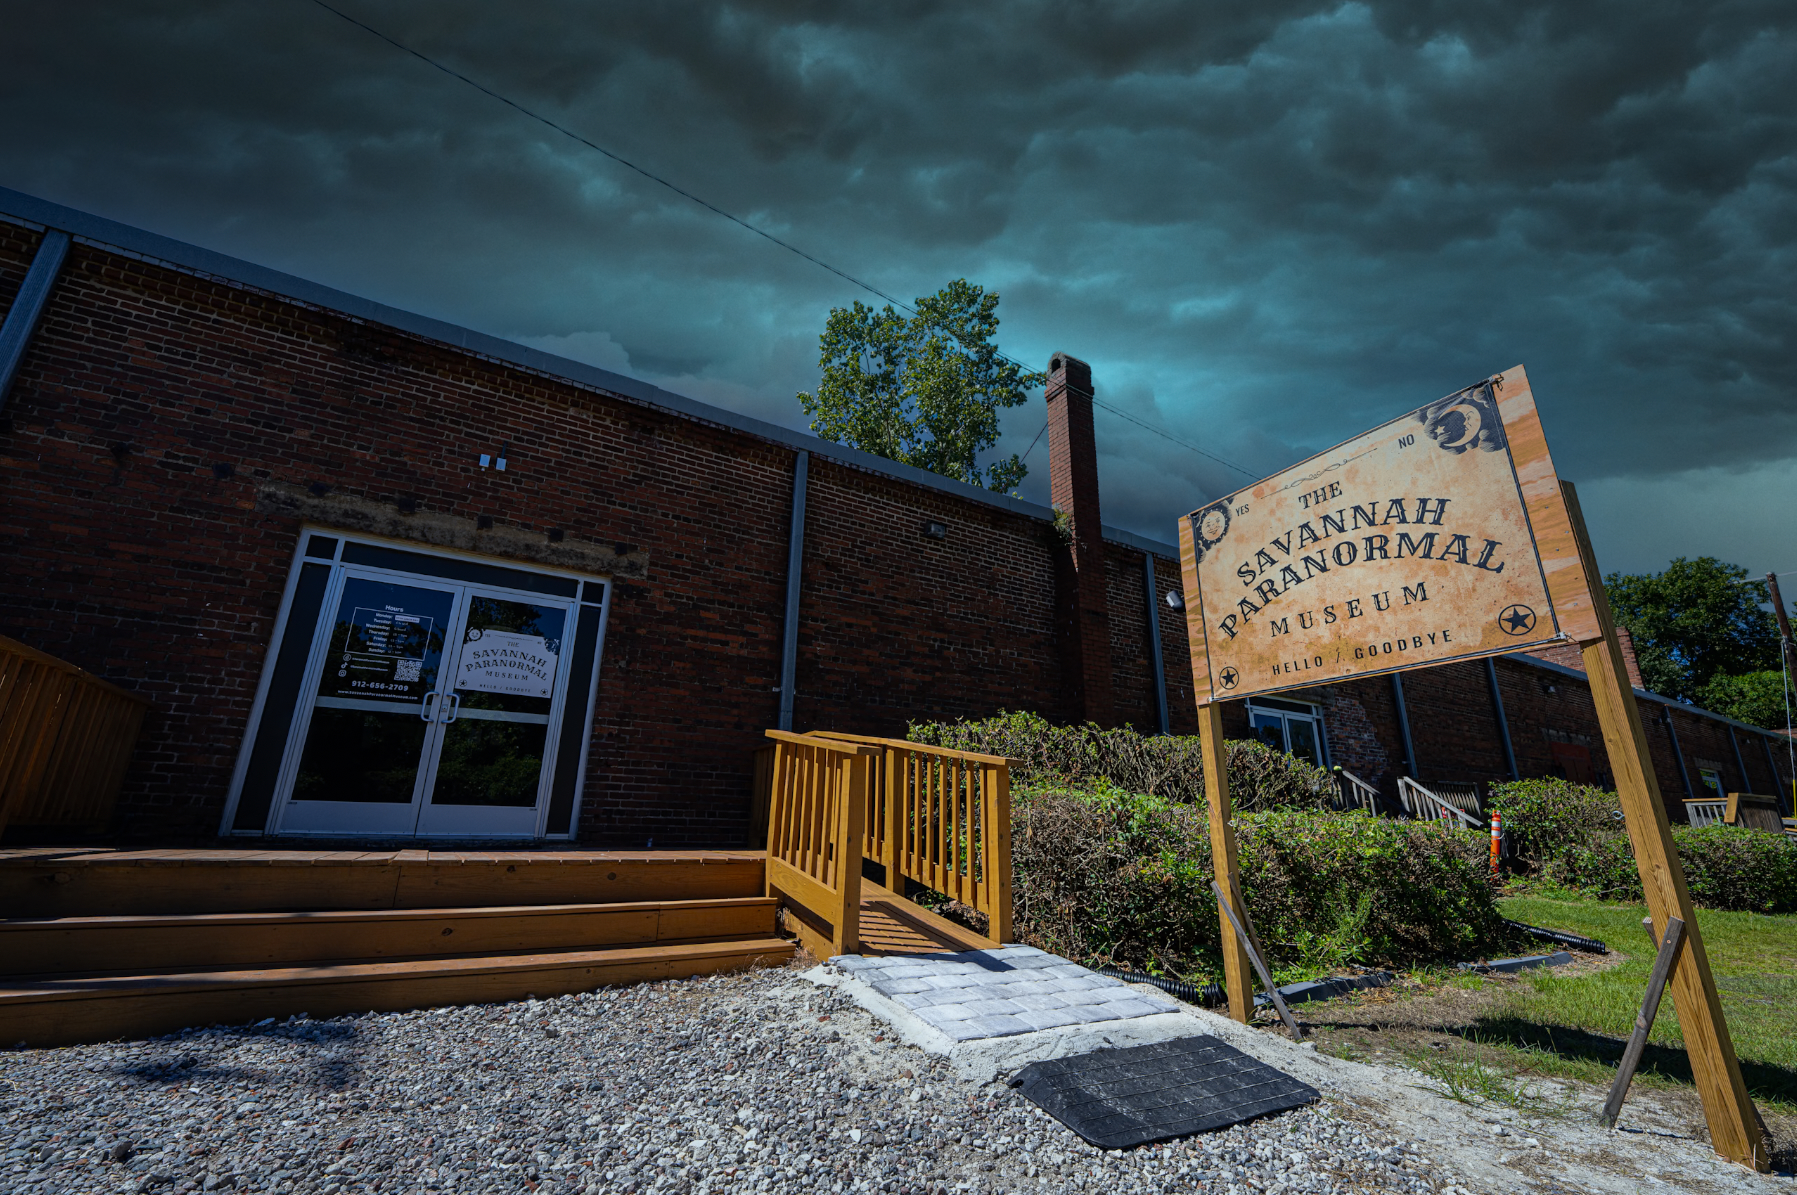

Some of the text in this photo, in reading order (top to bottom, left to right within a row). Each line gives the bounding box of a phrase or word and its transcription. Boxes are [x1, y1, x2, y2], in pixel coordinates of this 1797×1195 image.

[1398, 433, 1415, 449] NO
[1298, 481, 1343, 510] THE
[1234, 503, 1250, 517] YES
[1237, 497, 1452, 588] SAVANNAH
[1218, 532, 1506, 641] PARANORMAL
[1269, 581, 1430, 638] MUSEUM
[472, 648, 548, 668] SAVANNAH
[1272, 655, 1324, 677] HELLO
[1354, 629, 1453, 661] GOODBYE
[465, 659, 548, 681] PARANORMAL
[485, 670, 529, 681] MUSEUM
[352, 680, 408, 691] 912-656-2709
